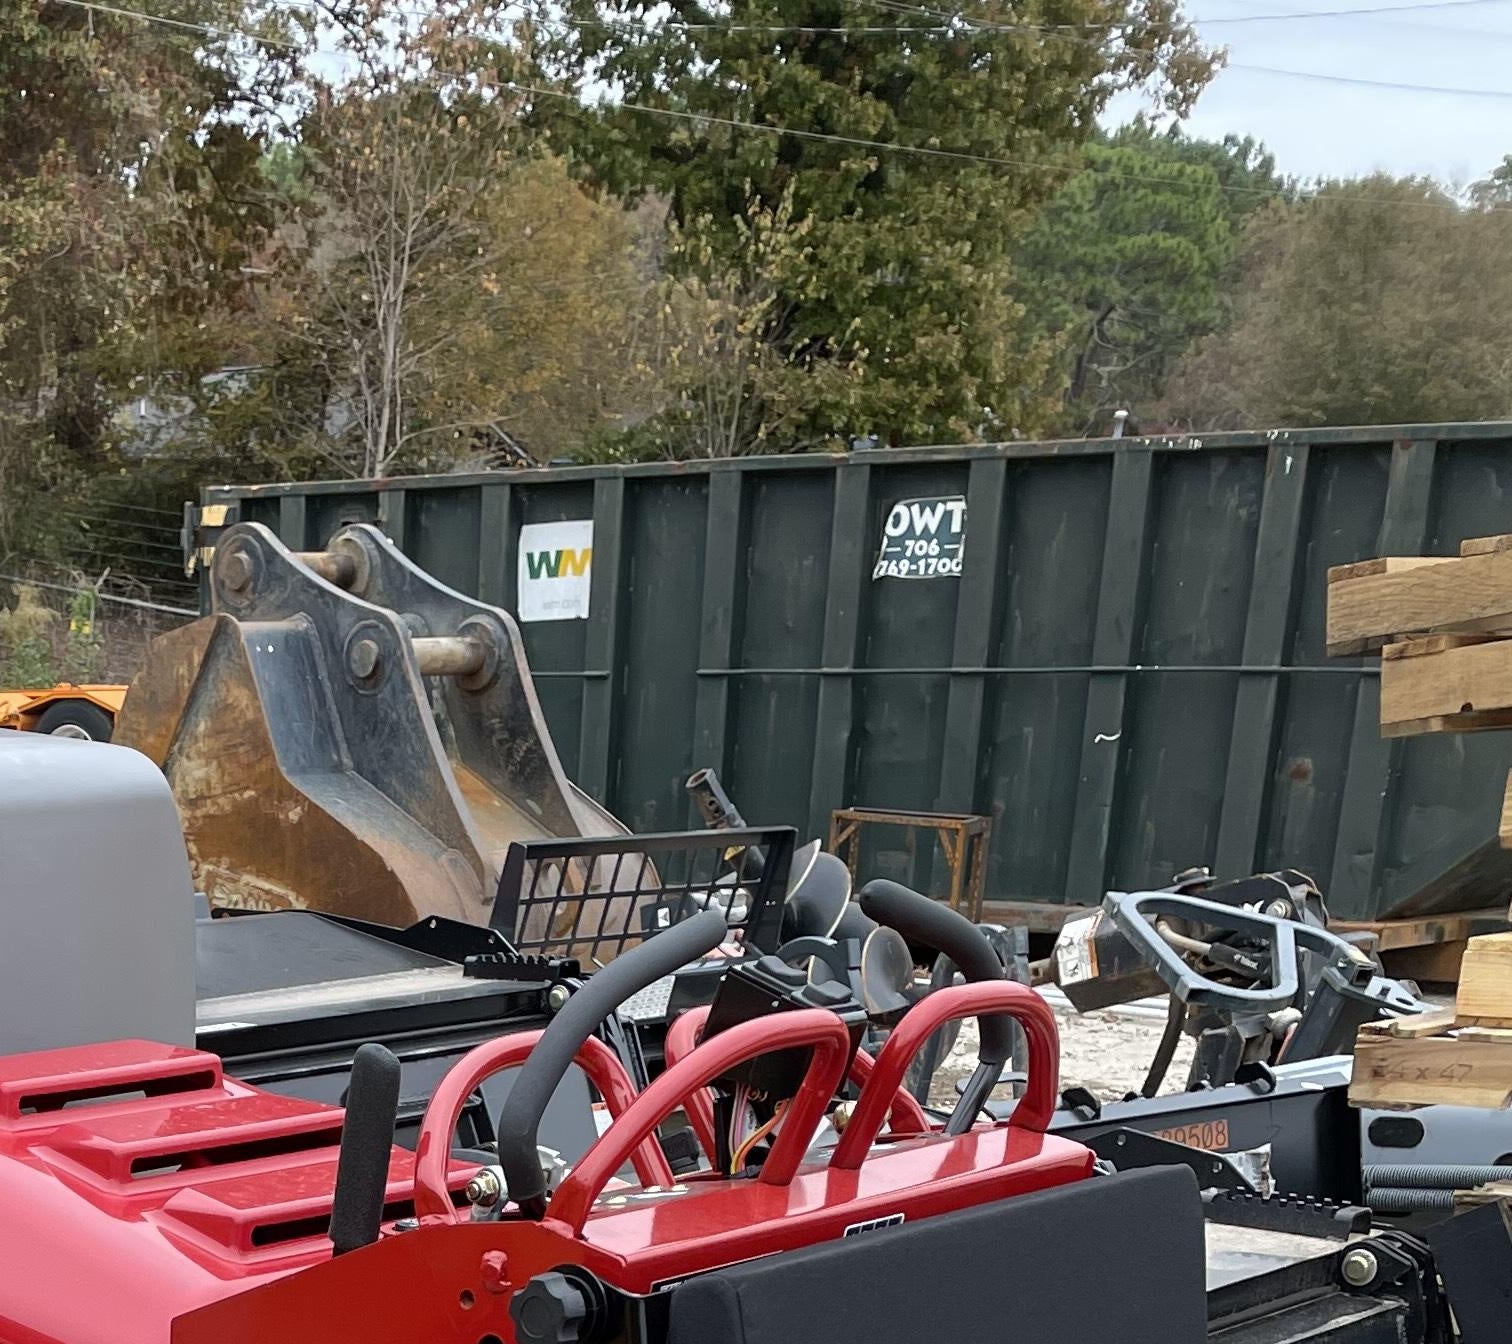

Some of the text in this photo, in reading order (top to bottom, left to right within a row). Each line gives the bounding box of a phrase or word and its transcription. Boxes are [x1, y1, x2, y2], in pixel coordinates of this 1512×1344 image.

[885, 501, 967, 536] OWT
[905, 538, 940, 557] 706
[526, 548, 594, 579] WM
[878, 558, 963, 576] 769-1700
